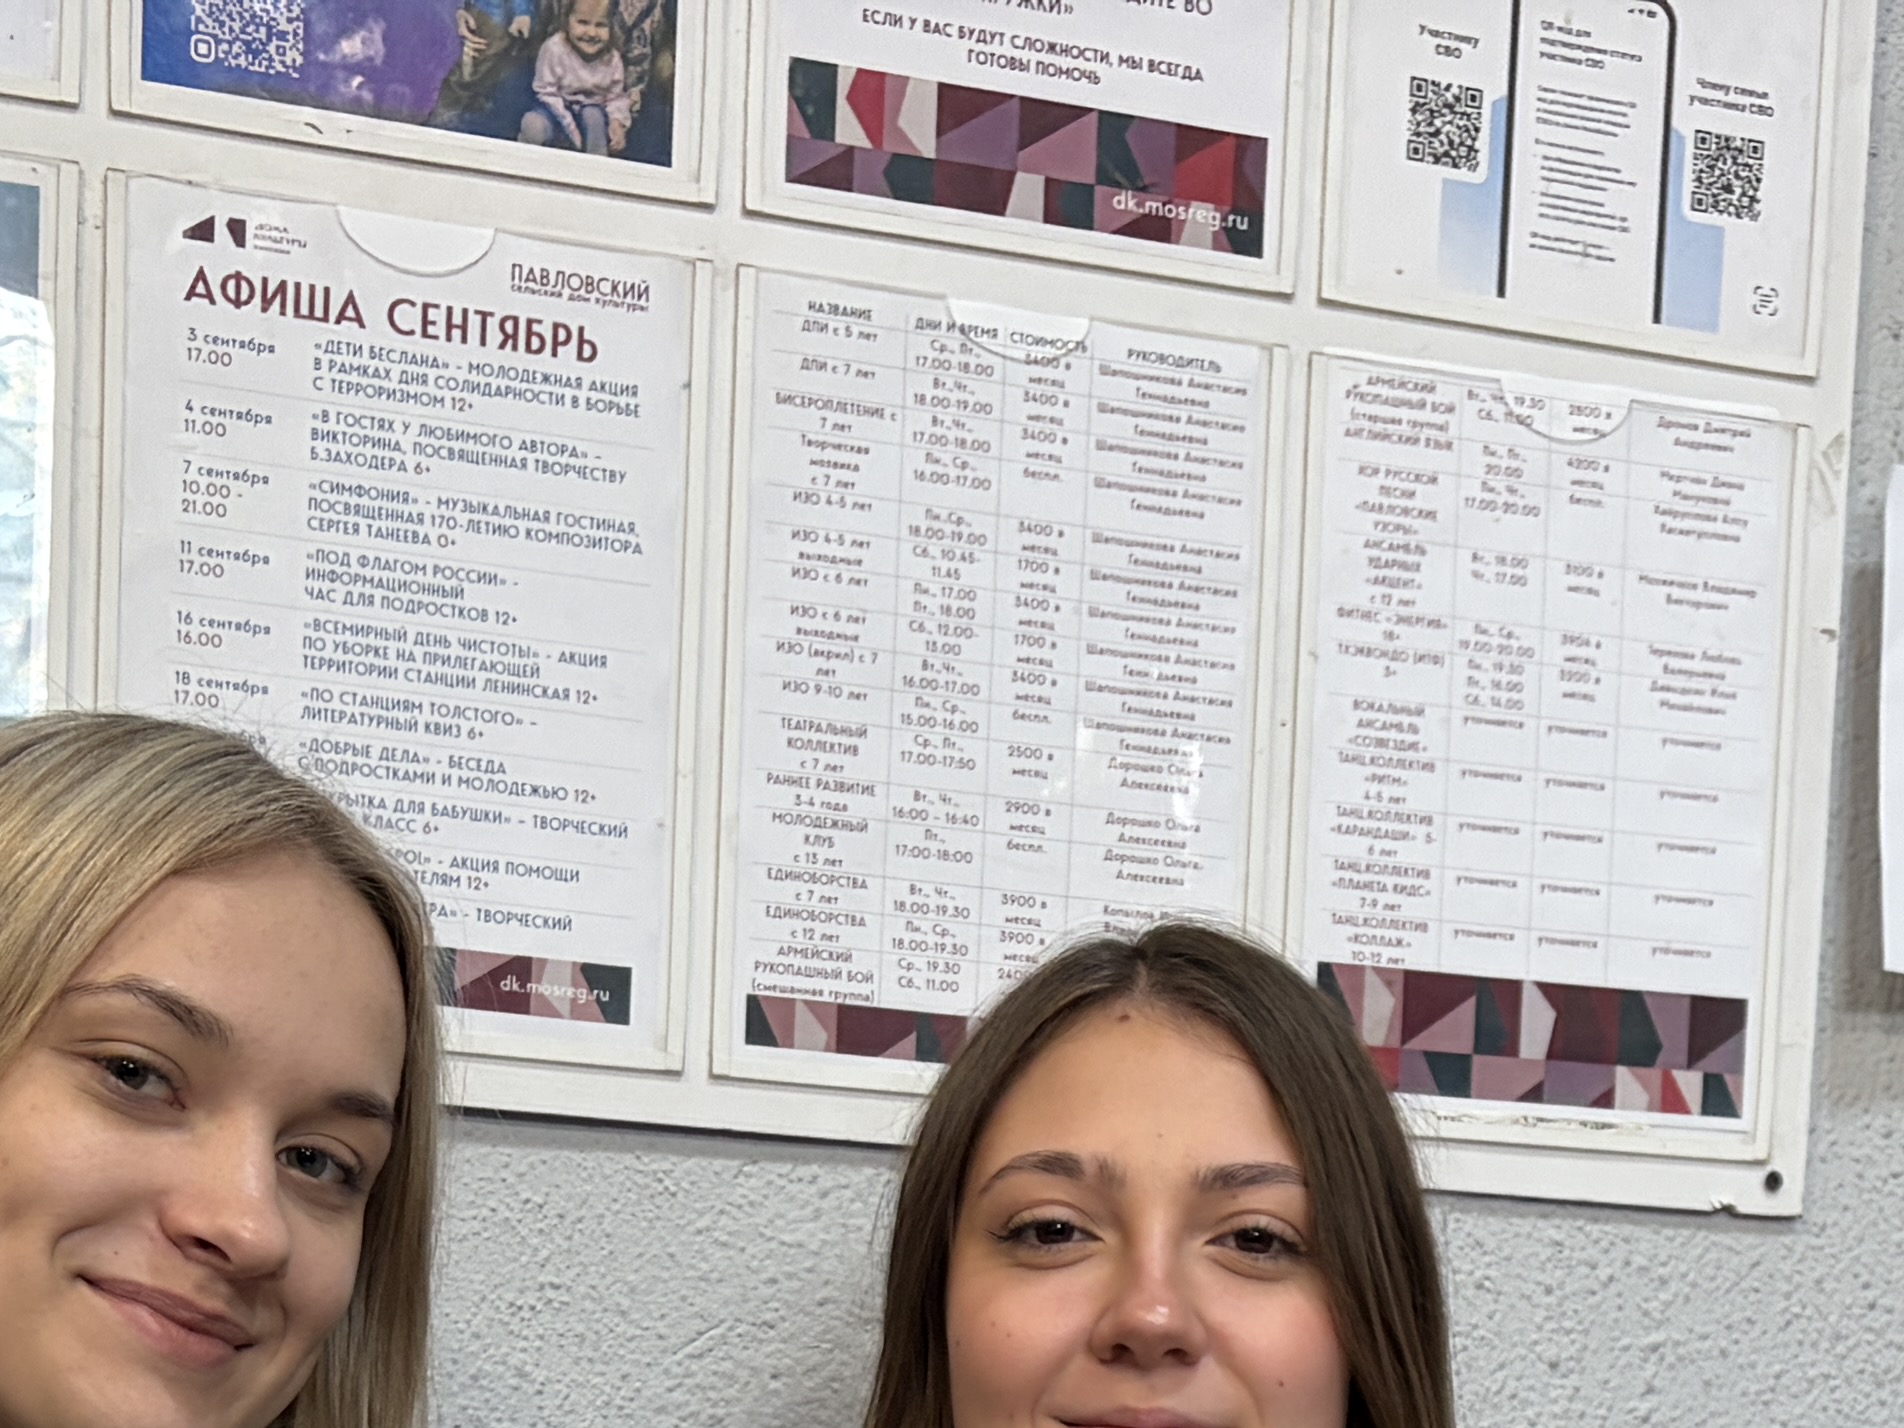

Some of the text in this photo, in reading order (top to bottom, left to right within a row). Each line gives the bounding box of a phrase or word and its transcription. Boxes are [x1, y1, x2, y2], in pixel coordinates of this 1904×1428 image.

[862, 9, 1203, 83] ЕСЛИ У ВАС БУДУТ СЛОЖНОСТИ, МЫ ВСЕГДА
[967, 49, 1101, 85] ГОТОВЫ ПОМОЧЬ
[1112, 192, 1248, 231] dk.mosreg.ru
[511, 263, 650, 303] ПАВЛОВСКИЙ
[184, 265, 598, 363] АФИША СЕНТЯБРЬ
[187, 328, 275, 357] 3 сентября
[187, 348, 232, 367] 17.00
[314, 340, 638, 398] «ДЕТИ БЕСЛАНА» МОЛОДЕЖНАЯ АКЦИЯ
[313, 377, 324, 391] С
[330, 377, 445, 407] ТЕРРОРИЗМОМ
[314, 358, 640, 418] В РАМКАХ ДНЯ СОЛИДАРНОСТИ В БОРЬБЕ
[184, 419, 227, 438] 11.00
[185, 399, 273, 427] 4 сентября
[312, 410, 588, 460] «В ГОСТЯХ У ЛЮБИМОГО АВТОРА»
[300, 688, 523, 727] «ПО СТАНЦИЯМ ТОЛСТОГО»
[300, 705, 418, 733] ЛИТЕРАТУРНЫЙ
[425, 721, 461, 738] КВИЗ
[500, 975, 609, 1003] dk.mosreg.ru
